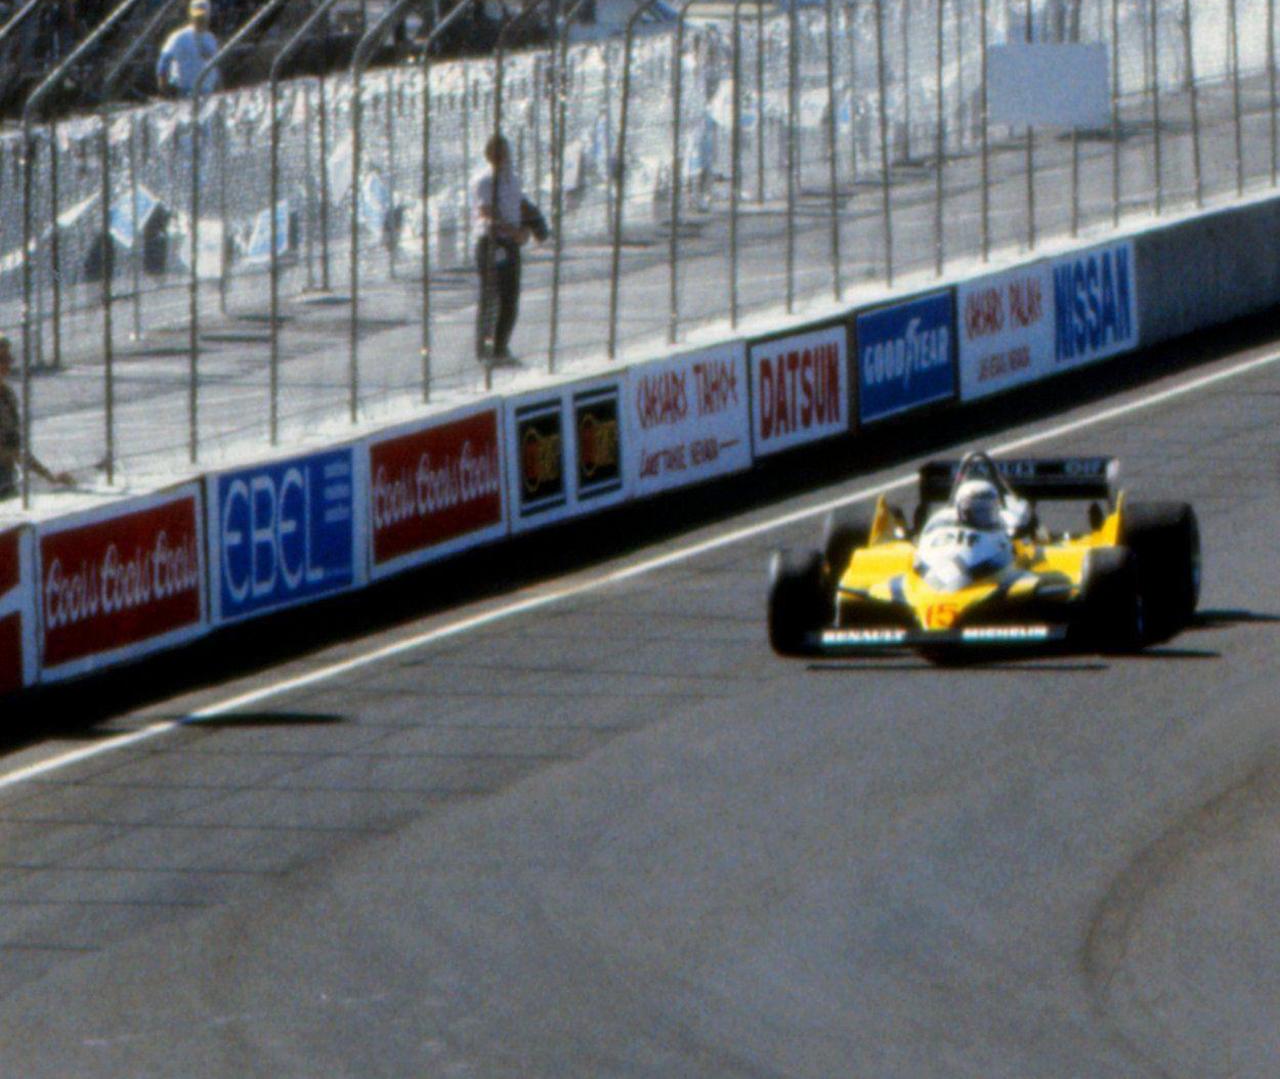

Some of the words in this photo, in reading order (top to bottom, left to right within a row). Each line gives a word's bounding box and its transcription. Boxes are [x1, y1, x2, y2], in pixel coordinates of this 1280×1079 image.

[1053, 243, 1131, 363] NISSAN
[637, 369, 688, 430] CAESARS
[692, 357, 739, 418] TAHOE
[760, 340, 840, 442] DATSUN
[223, 466, 324, 603] EBEL
[926, 602, 957, 627] 15
